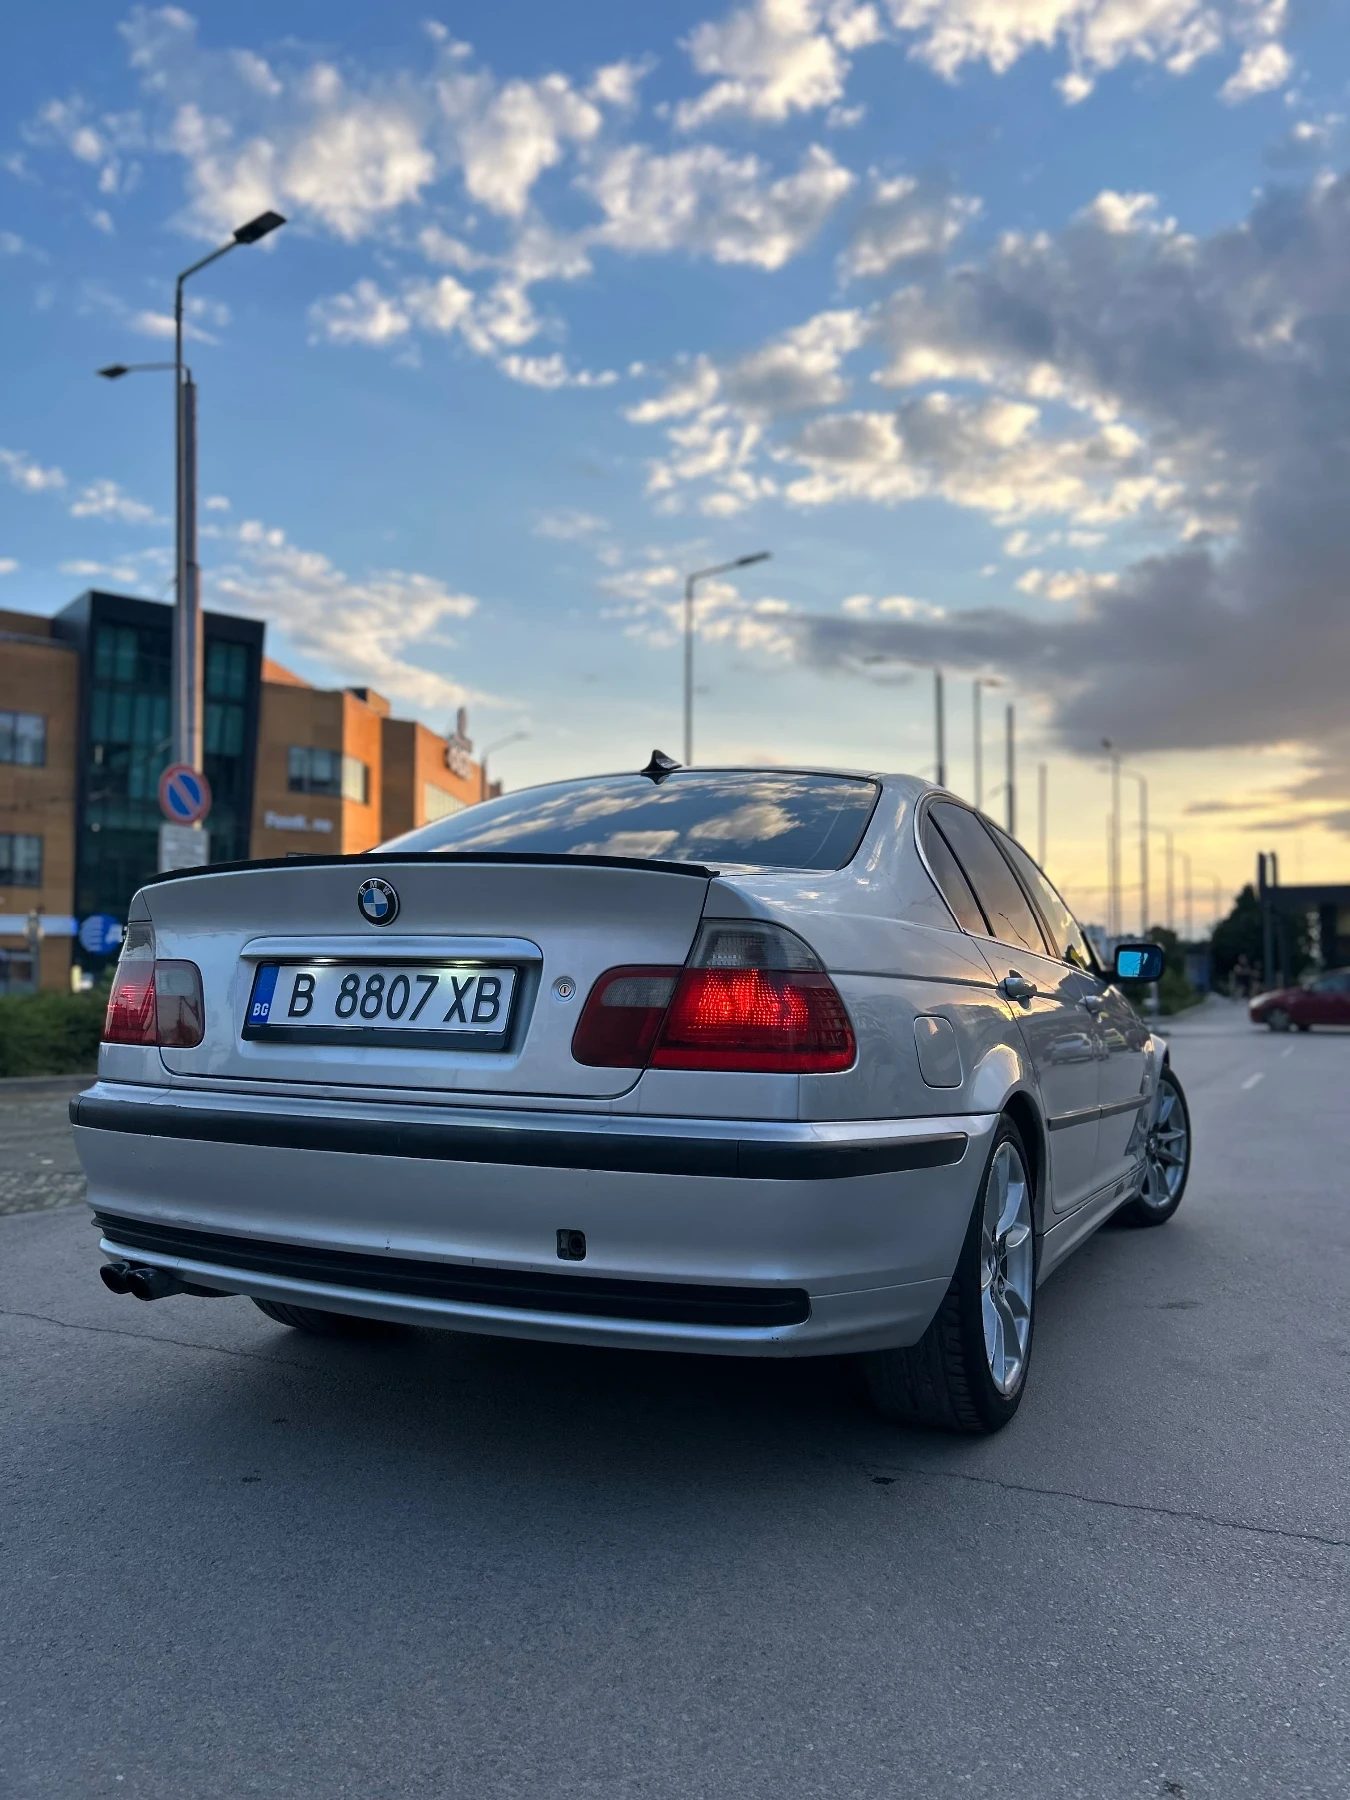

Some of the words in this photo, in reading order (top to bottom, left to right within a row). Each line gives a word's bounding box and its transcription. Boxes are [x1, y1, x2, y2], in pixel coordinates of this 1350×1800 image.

[359, 880, 392, 896] BMW
[288, 973, 316, 1018] B
[334, 973, 440, 1021] 8807
[442, 976, 502, 1023] XB
[252, 1003, 269, 1016] BG
